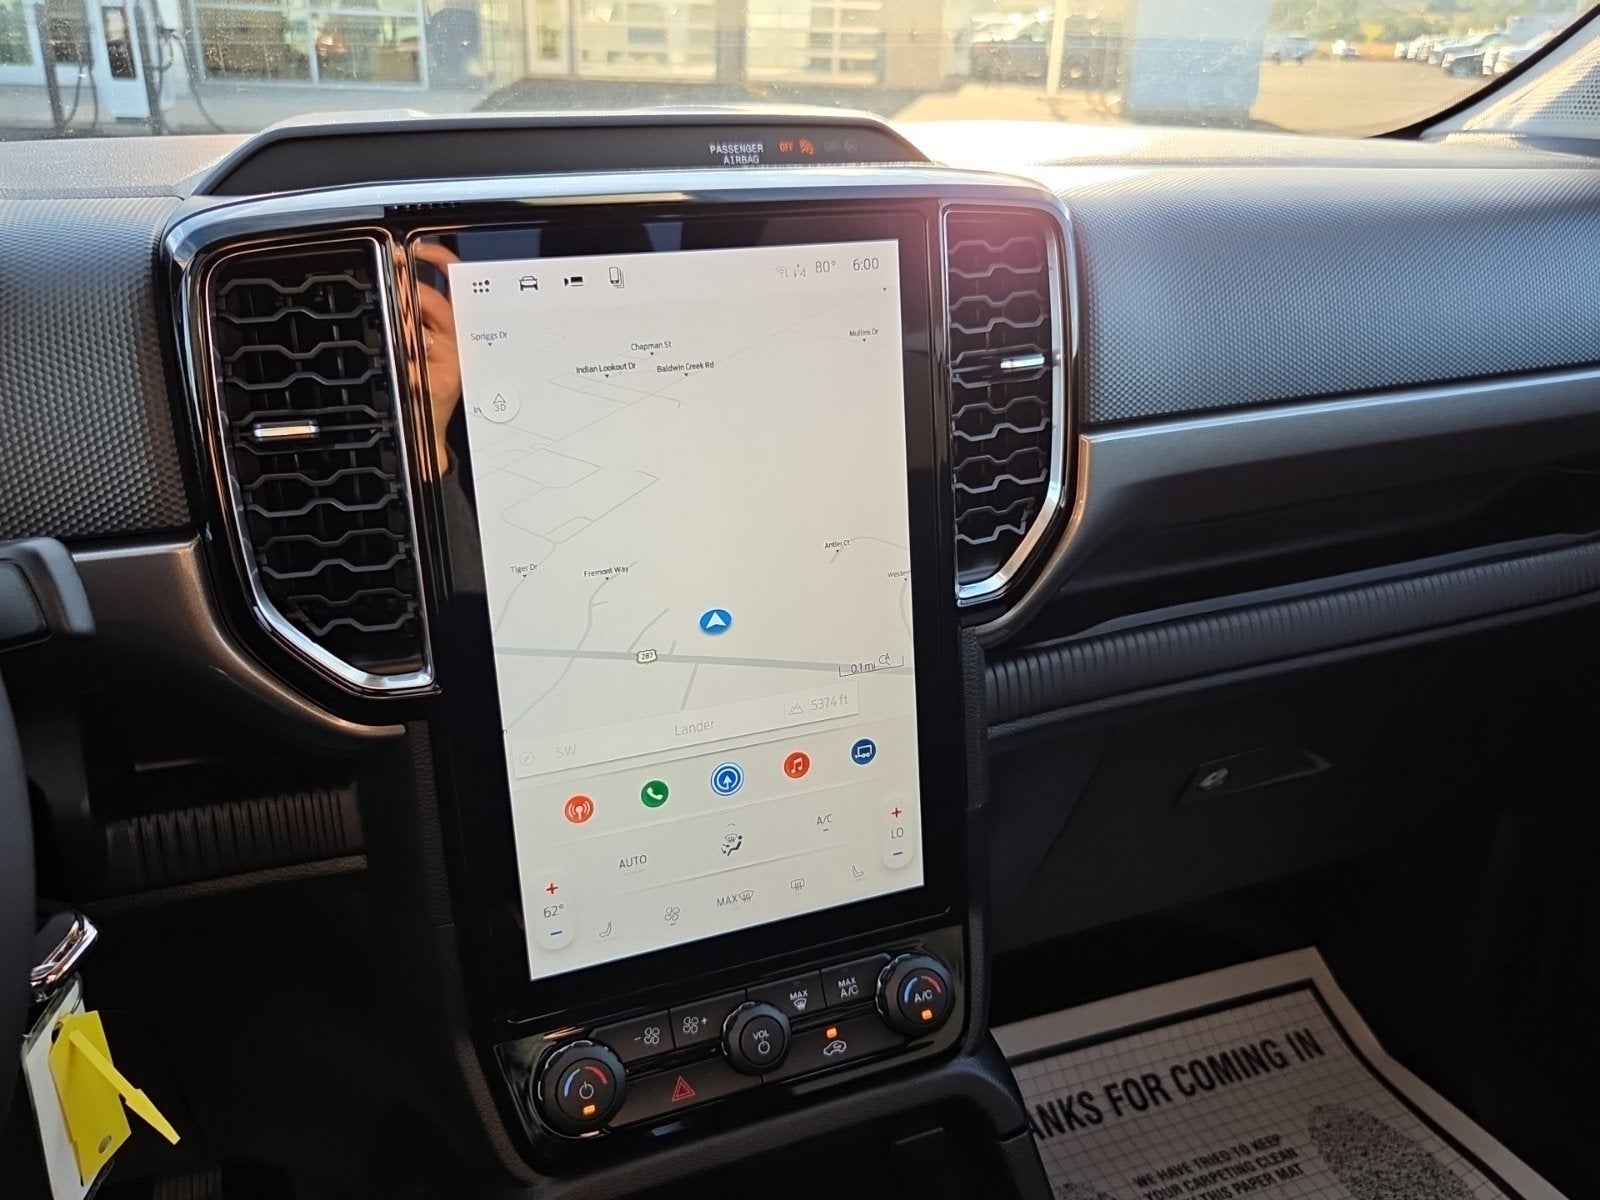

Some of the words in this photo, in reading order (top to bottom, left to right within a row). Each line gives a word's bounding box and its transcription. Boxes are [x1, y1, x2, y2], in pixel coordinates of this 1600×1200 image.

[709, 144, 764, 154] PASSENGER
[779, 142, 794, 152] OFF
[723, 155, 760, 165] AIRBAG
[852, 258, 879, 271] 6:00
[470, 331, 498, 341] Spriggs
[499, 331, 508, 339] Dr
[630, 343, 663, 351] Chapman
[576, 366, 598, 374] Indian
[599, 363, 627, 372] Lookout
[628, 362, 636, 370] Dr
[656, 364, 685, 373] Baldwin
[685, 362, 704, 371] Creek
[705, 361, 715, 369] Rd
[494, 404, 506, 412] 3D
[510, 565, 529, 574] Tiger
[529, 563, 538, 571] Dr
[583, 568, 613, 577] Fremont
[613, 566, 629, 574] Way
[641, 652, 653, 660] 287
[811, 698, 838, 711] 5374
[839, 694, 849, 705] ft
[674, 720, 715, 736] Lander
[556, 744, 577, 758] SW
[816, 813, 833, 826] A/C
[890, 827, 904, 840] LO
[618, 854, 648, 869] AUTO
[716, 894, 738, 908] MAX
[837, 977, 857, 989] MAX
[789, 989, 809, 1000] MAX
[840, 984, 859, 998] A/C
[914, 991, 933, 1003] A/C
[752, 1029, 770, 1040] VOL
[1028, 1090, 1104, 1141] ANKS
[1103, 1072, 1172, 1116] FOR
[1169, 1039, 1289, 1097] COMING
[1285, 1026, 1325, 1061] IN
[1133, 1173, 1157, 1188] WE
[1156, 1161, 1194, 1182] HAVE
[1193, 1150, 1231, 1170] TRIED
[1231, 1143, 1251, 1157] TO
[1250, 1133, 1281, 1151] KEEP
[1143, 1183, 1184, 1200] YOUR
[1182, 1160, 1257, 1192] CARPETING
[1254, 1147, 1299, 1169] CLEAN
[1200, 1185, 1234, 1200] THIS
[1232, 1172, 1277, 1194] PAPER
[1275, 1163, 1304, 1181] MAT
